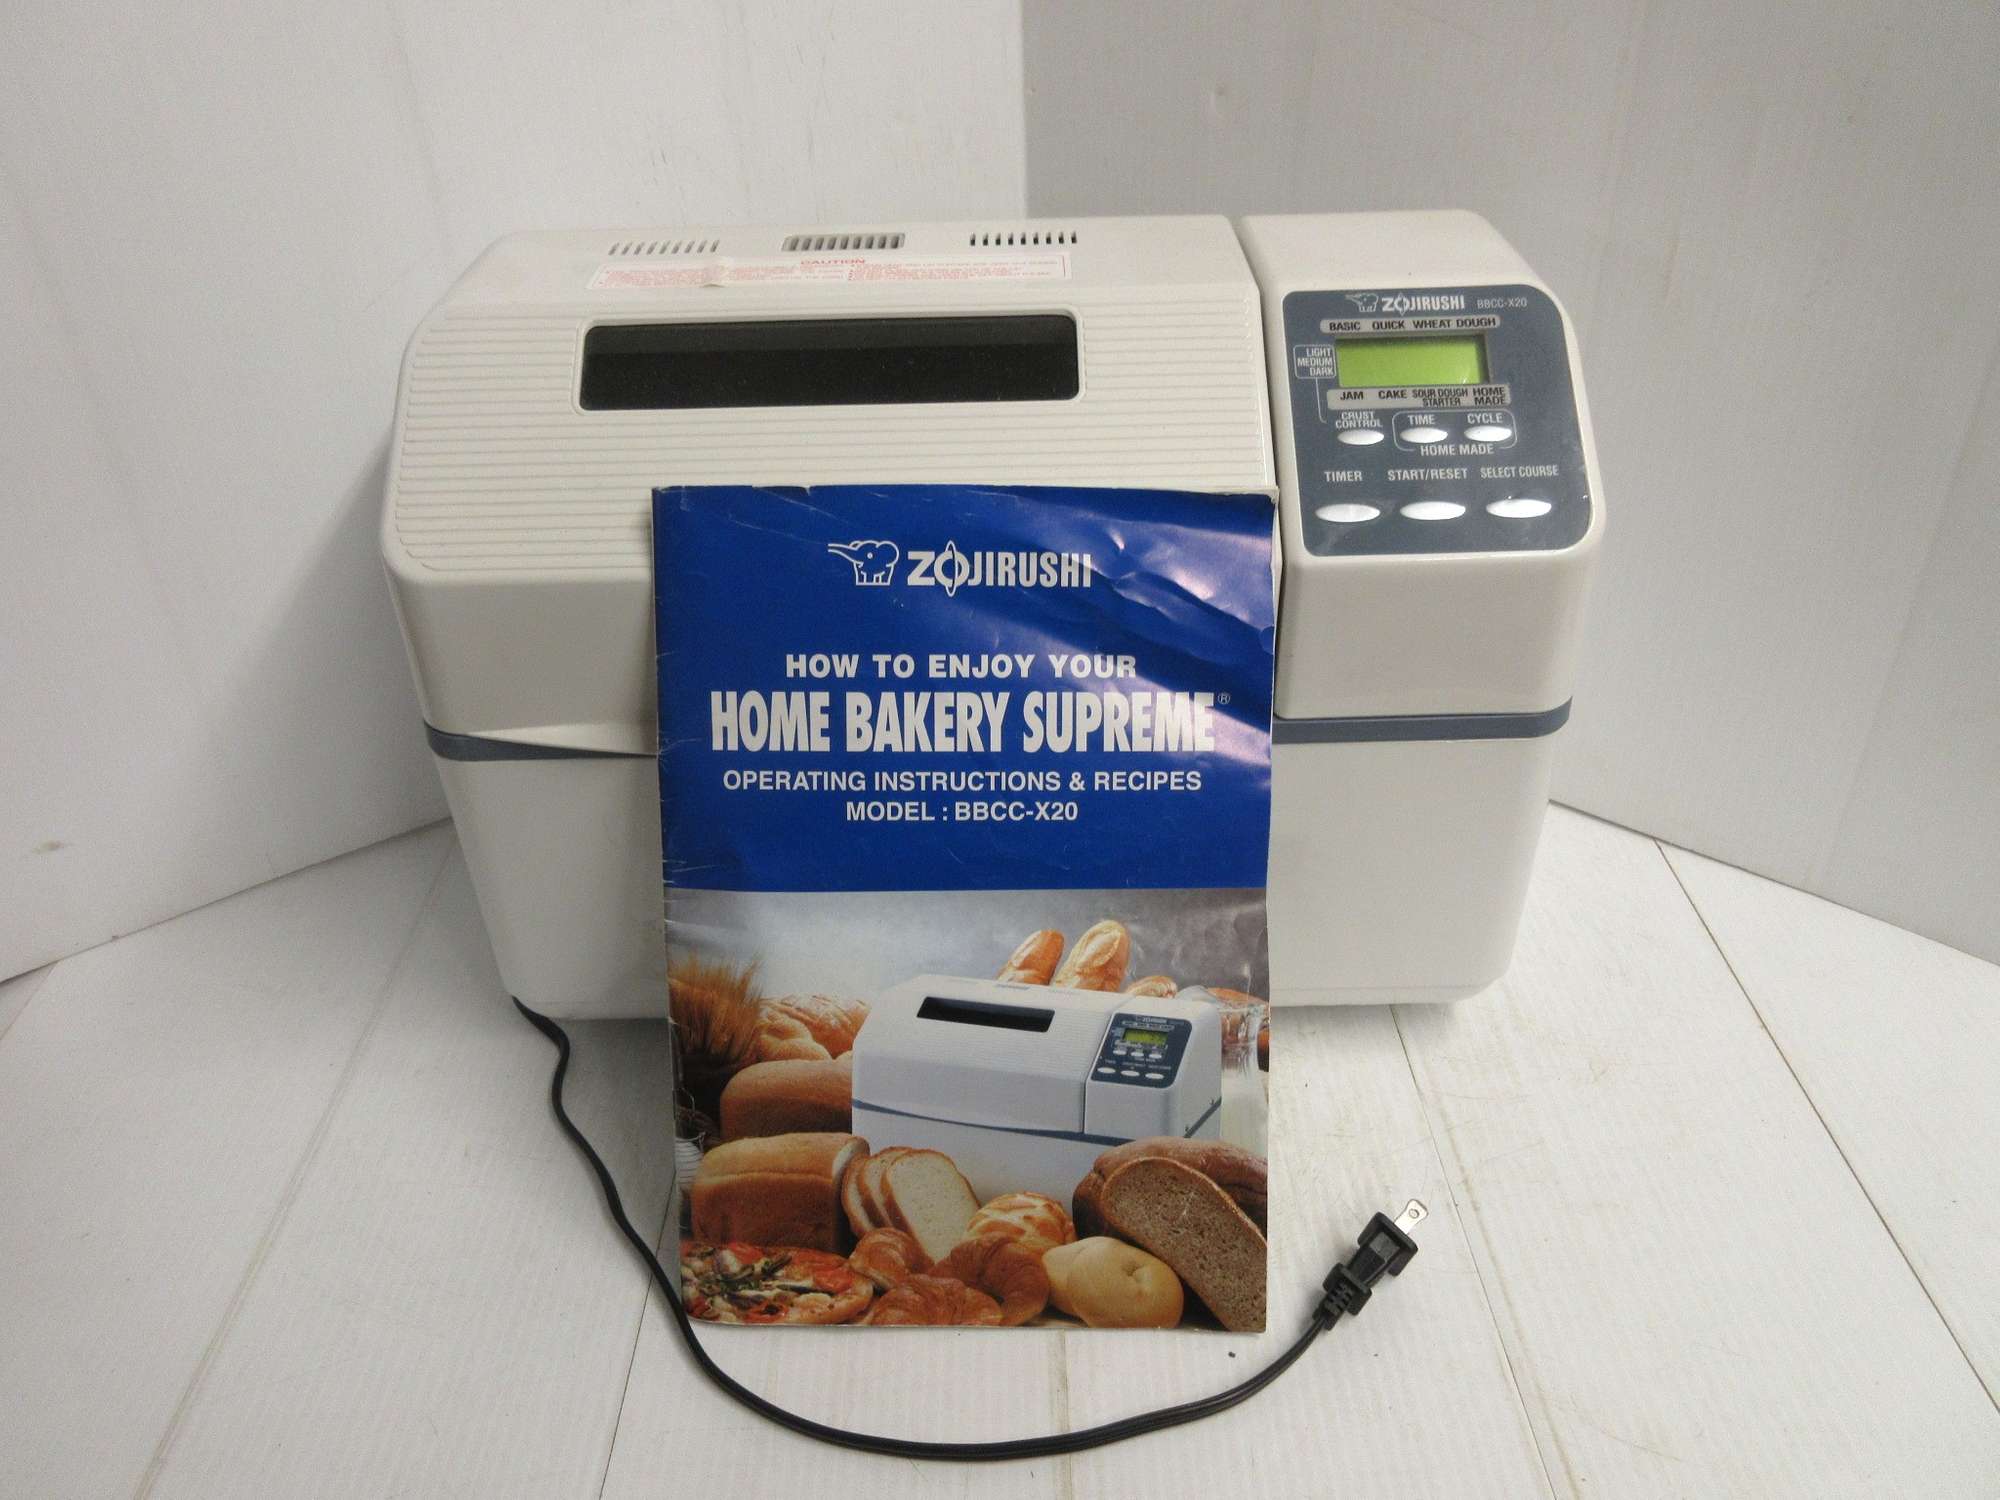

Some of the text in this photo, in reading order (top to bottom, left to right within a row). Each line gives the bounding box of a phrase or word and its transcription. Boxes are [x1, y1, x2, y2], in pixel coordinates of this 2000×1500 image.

[1381, 293, 1465, 315] ZOJIRUSHI
[1477, 298, 1528, 309] BBCC-X20
[1329, 317, 1496, 331] BASIC QUICK WHEAT DOUGH
[1306, 347, 1331, 357] LIGHT
[1297, 357, 1333, 367] MEDIUM
[1309, 366, 1333, 376] DARK
[1340, 390, 1364, 401] JAM
[1378, 389, 1407, 399] CAKE
[1412, 388, 1468, 398] SOUR DOUGH
[1473, 387, 1505, 396] HOME
[1422, 397, 1461, 407] STARTER
[1475, 396, 1506, 405] MADE
[1341, 411, 1374, 421] CRUST
[1408, 415, 1435, 425] TIME
[1467, 414, 1503, 424] CYCLE
[1335, 419, 1383, 428] CONTROL
[1420, 444, 1494, 456] HOME MADE
[1324, 471, 1362, 482] TIMER
[1387, 468, 1468, 481] START/RESET
[1480, 465, 1558, 478] SELECT COURSE
[907, 540, 1091, 597] ZOJIRUSHI
[786, 653, 1136, 679] HOW TO ENJOY YOUR
[710, 690, 831, 753] HOME
[845, 690, 1009, 754] BAKERY
[723, 769, 1202, 792] OPERATING INSTRUCTIONS & RECIPES
[845, 801, 935, 822] MODEL
[955, 801, 1079, 822] BBCC-X20
